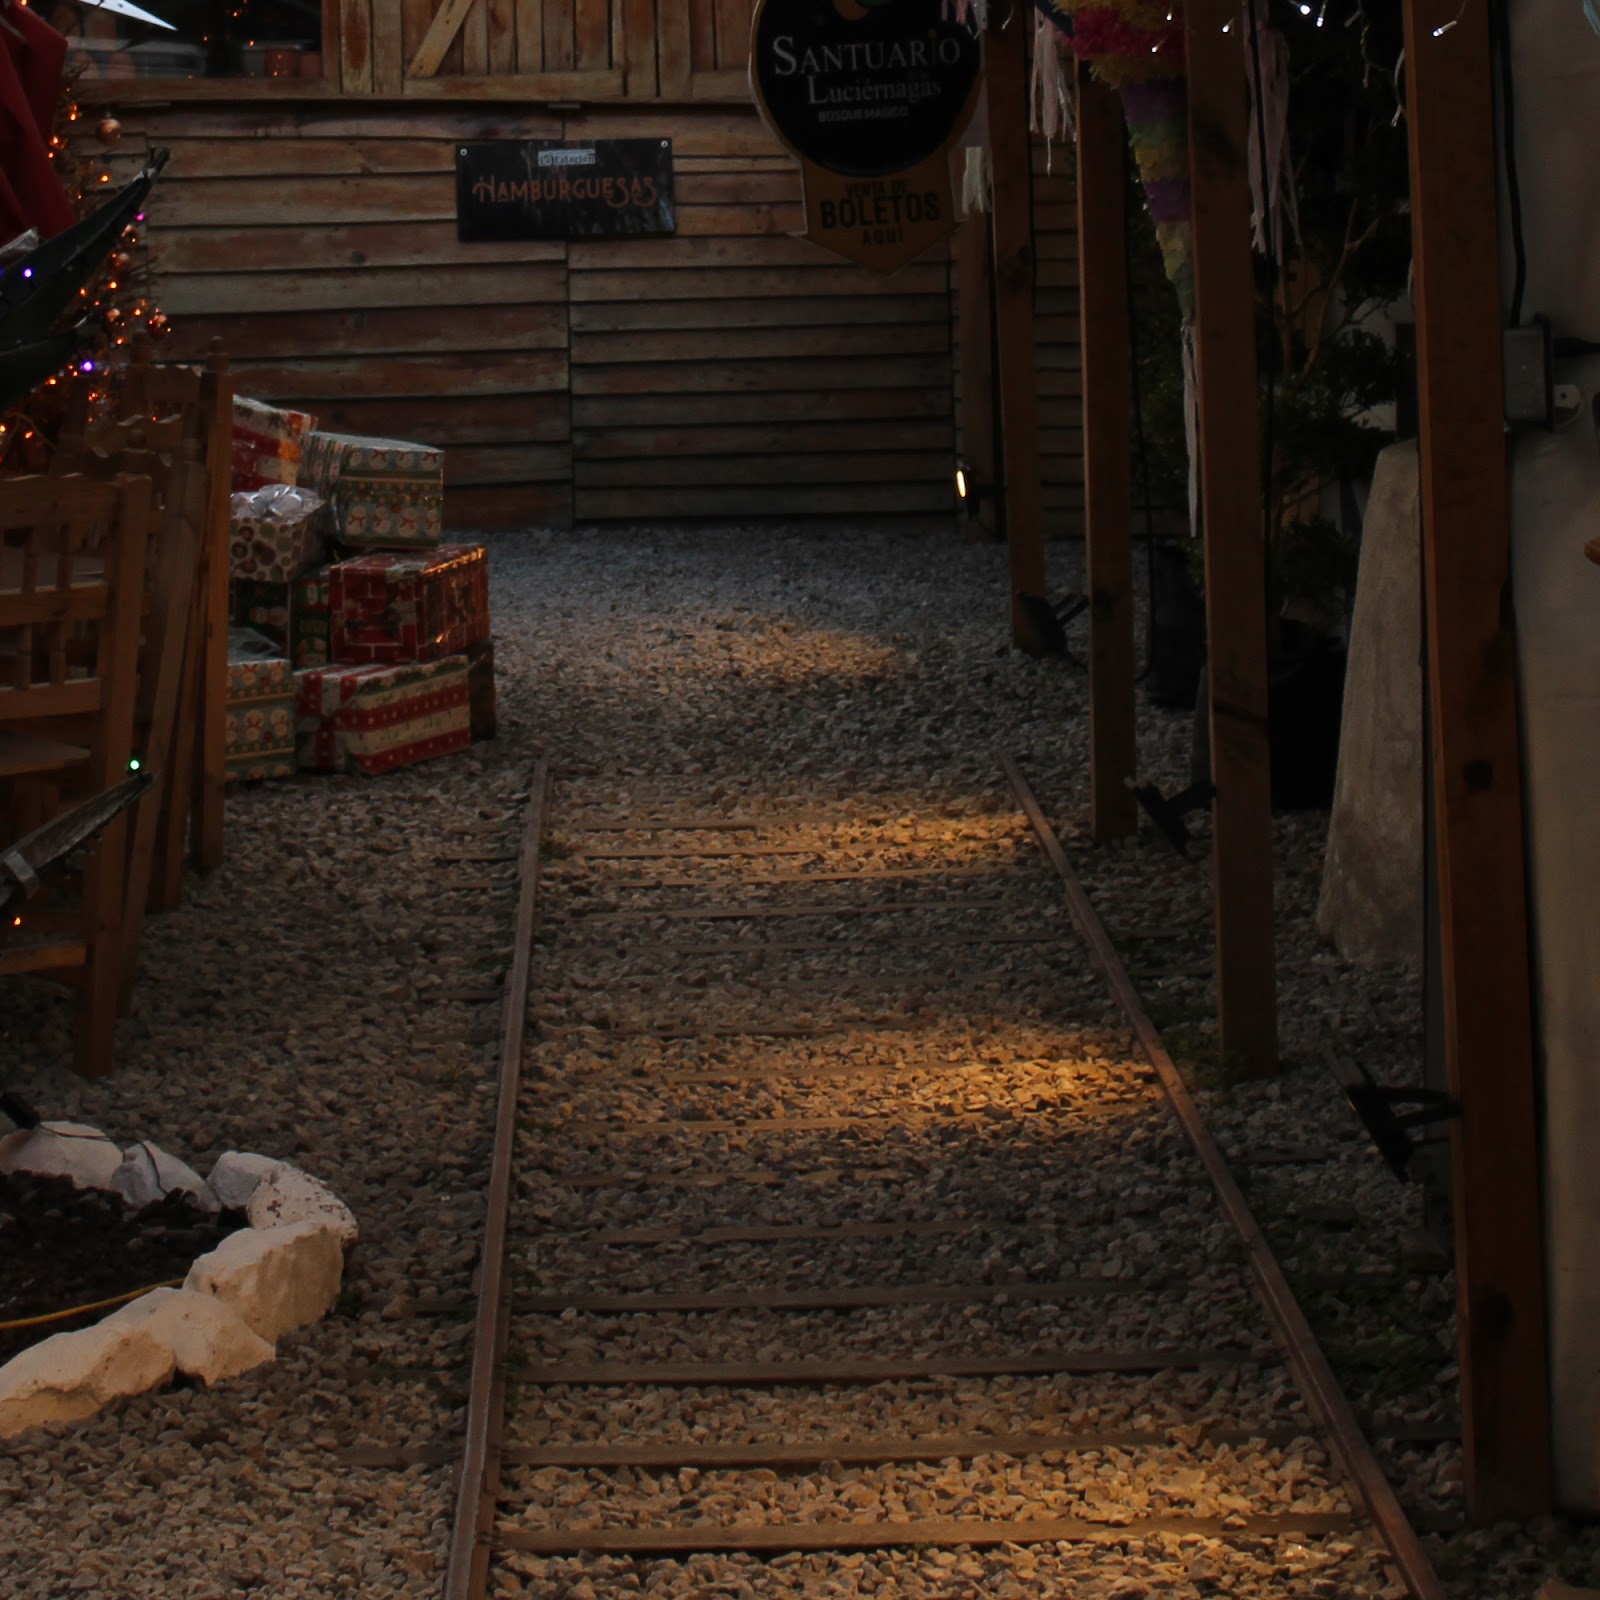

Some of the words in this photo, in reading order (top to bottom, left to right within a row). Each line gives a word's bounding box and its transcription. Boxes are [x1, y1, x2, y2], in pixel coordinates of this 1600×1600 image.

[772, 27, 961, 76] SANTUARIO
[808, 74, 943, 105] Luciérnagas
[472, 175, 657, 208] HAMBURGUESAS
[820, 192, 941, 228] BOLETOS
